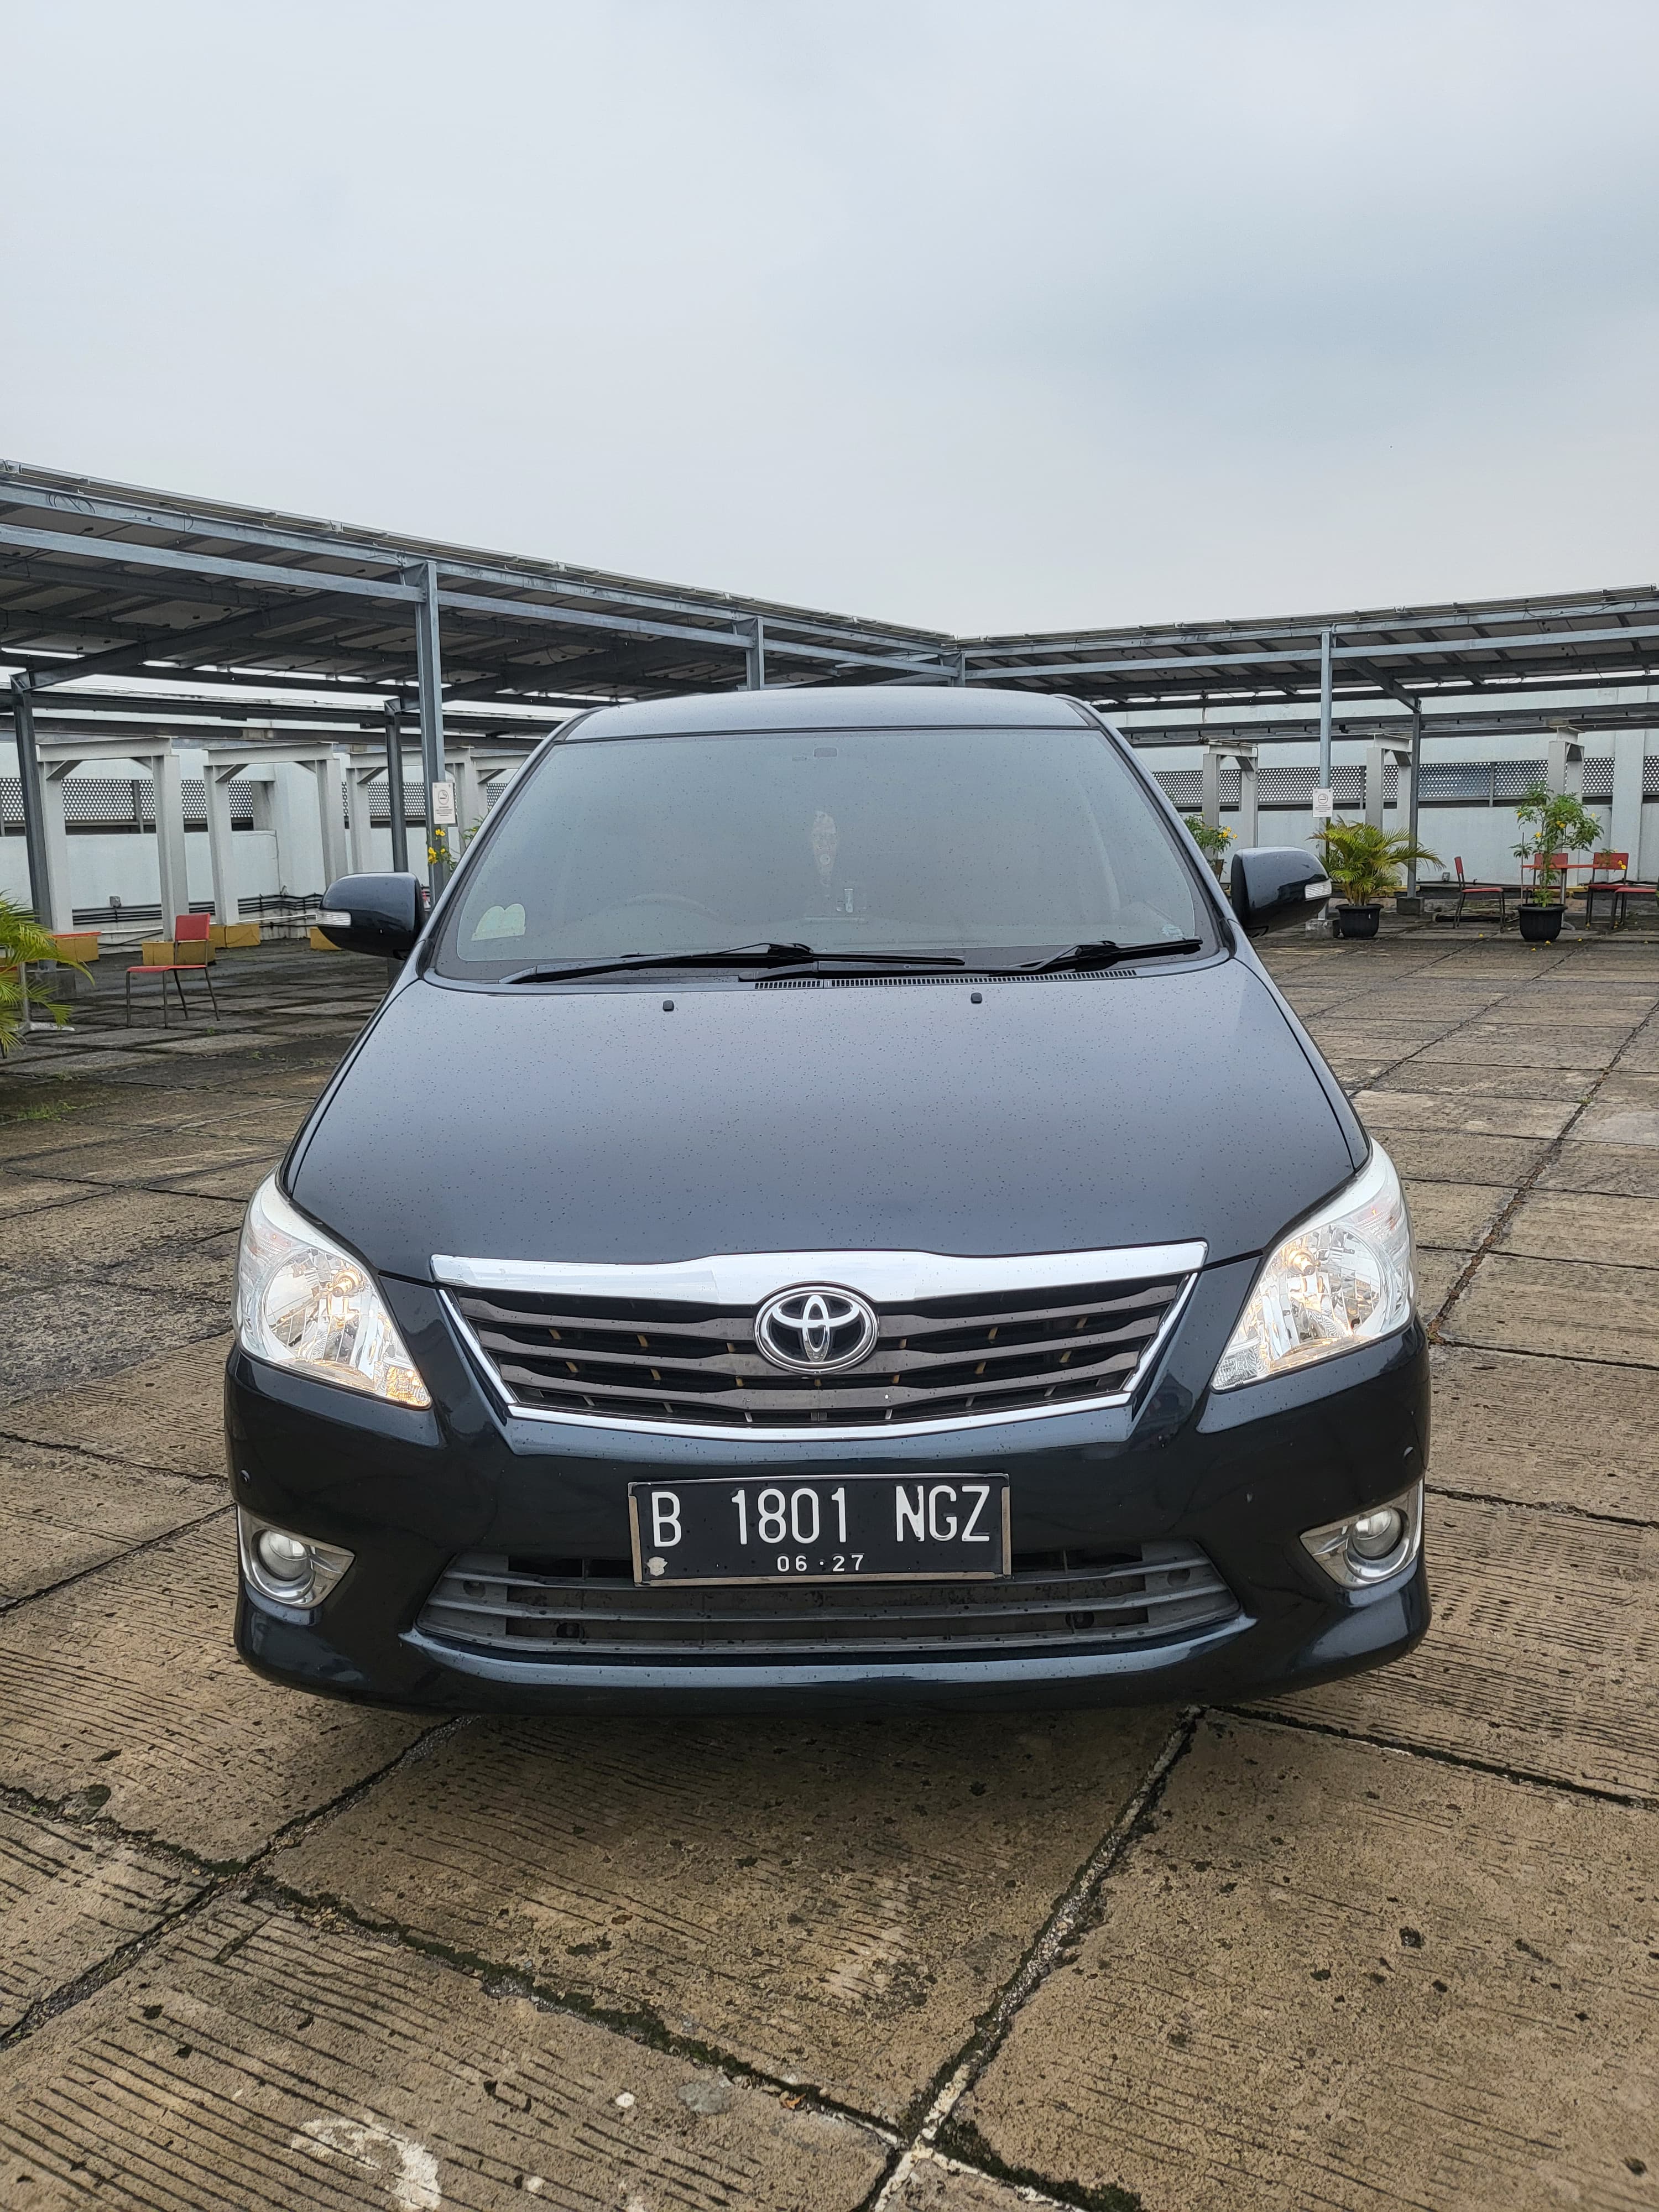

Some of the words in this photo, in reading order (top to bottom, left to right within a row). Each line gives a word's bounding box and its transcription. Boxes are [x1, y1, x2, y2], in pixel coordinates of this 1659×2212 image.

[651, 1491, 682, 1547] B
[732, 1487, 846, 1545] 1801
[896, 1485, 990, 1542] NGZ
